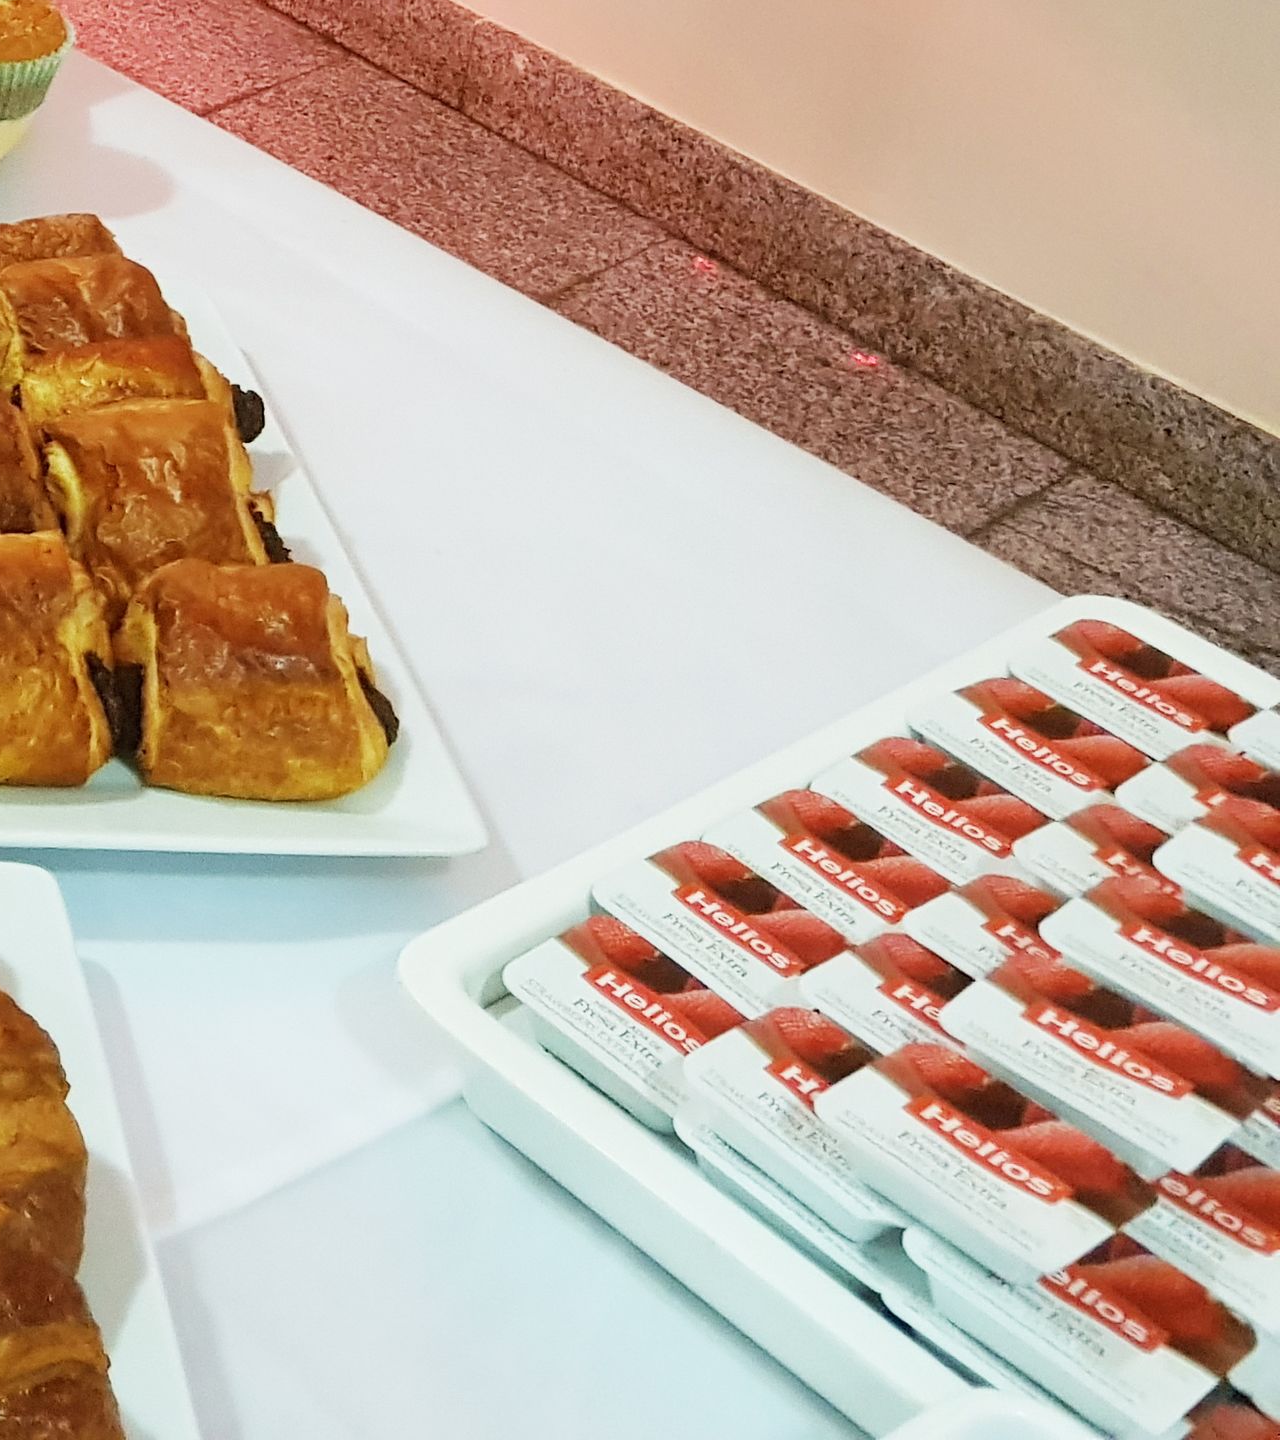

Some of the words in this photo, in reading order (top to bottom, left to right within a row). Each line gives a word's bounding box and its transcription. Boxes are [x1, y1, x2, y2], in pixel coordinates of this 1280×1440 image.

[1089, 661, 1196, 727] Helios
[990, 718, 1092, 787] Helios
[894, 780, 1003, 851] Helios
[790, 839, 898, 917] Helios
[686, 891, 790, 970] Helios
[1131, 928, 1269, 1006] Helios
[1037, 1010, 1175, 1092] Helios
[919, 1104, 1055, 1196] Helios
[1159, 1176, 1267, 1247] elios
[1047, 1269, 1149, 1343] elios
